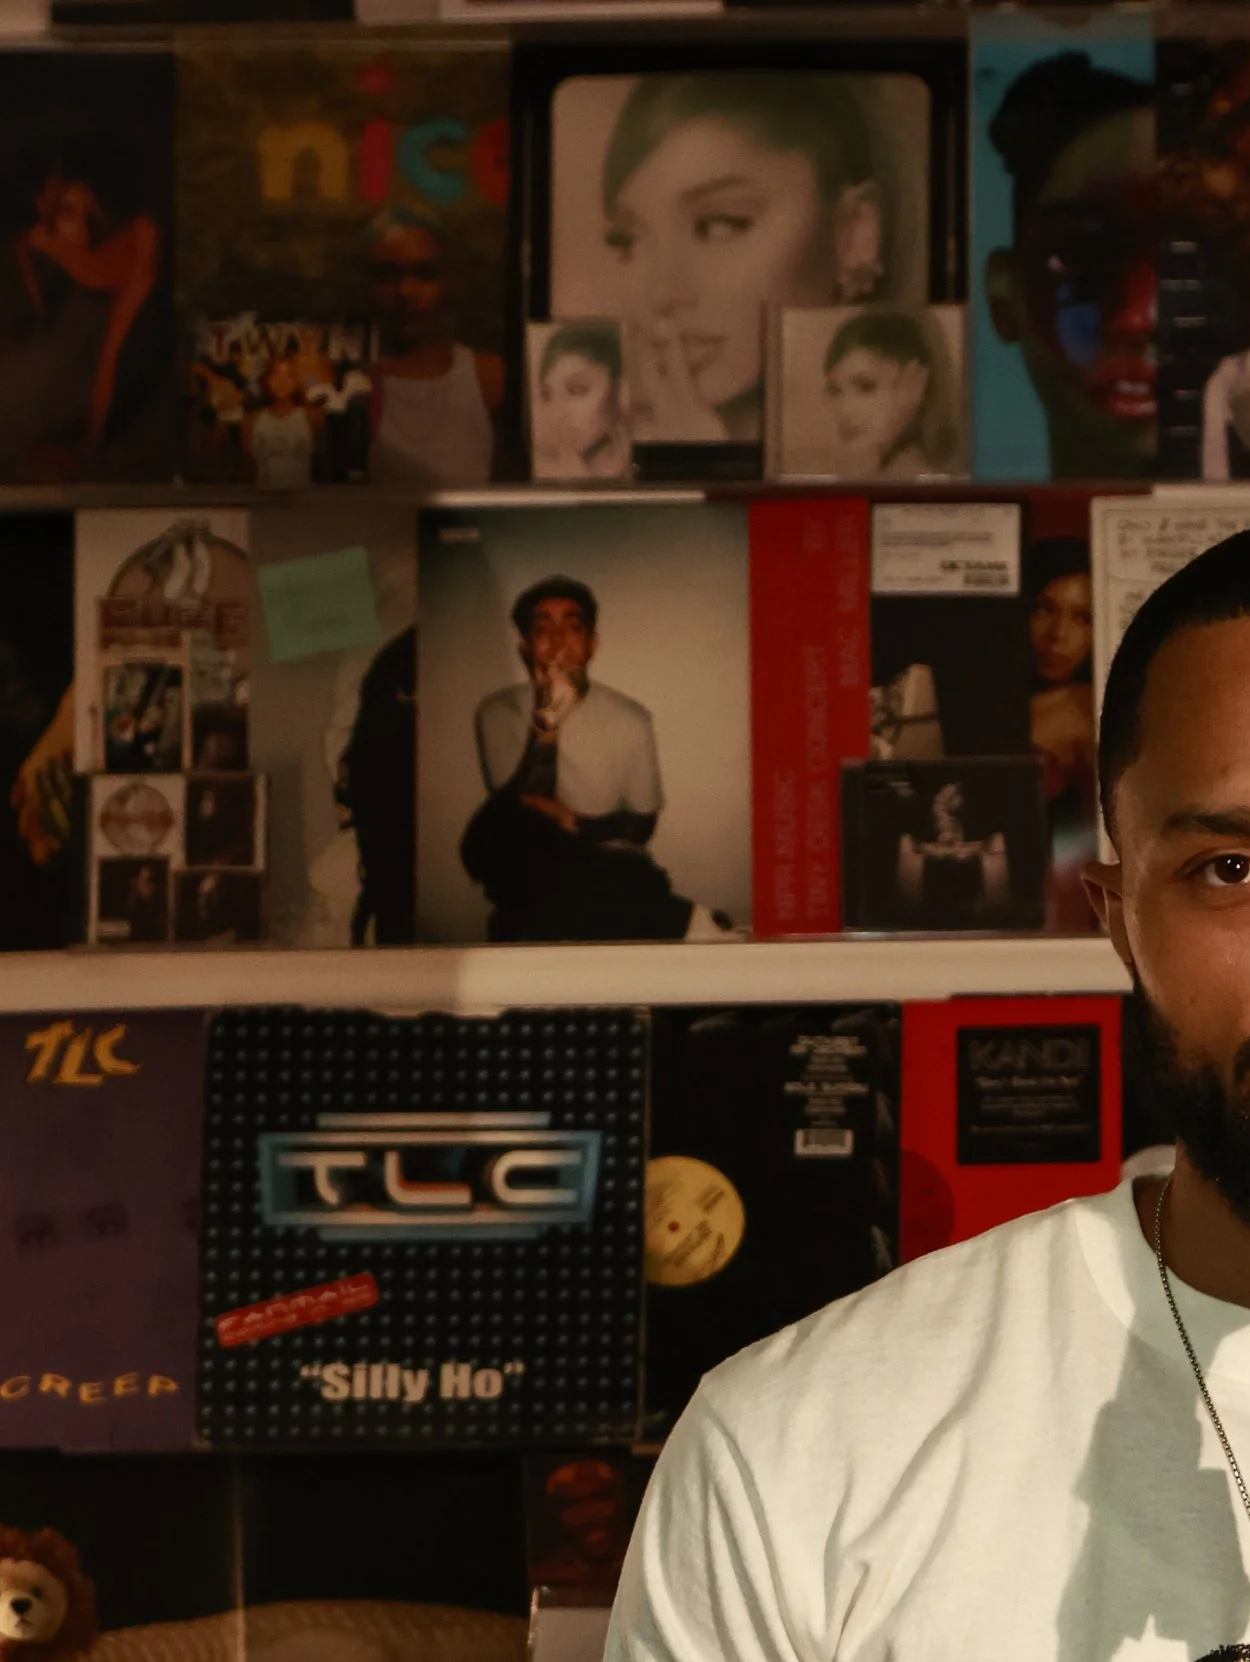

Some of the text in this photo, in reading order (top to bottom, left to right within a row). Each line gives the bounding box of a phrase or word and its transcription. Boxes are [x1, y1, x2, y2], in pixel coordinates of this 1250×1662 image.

[23, 1018, 142, 1087] TLC
[968, 1037, 1090, 1072] KANDI
[275, 1148, 584, 1208] TLC
